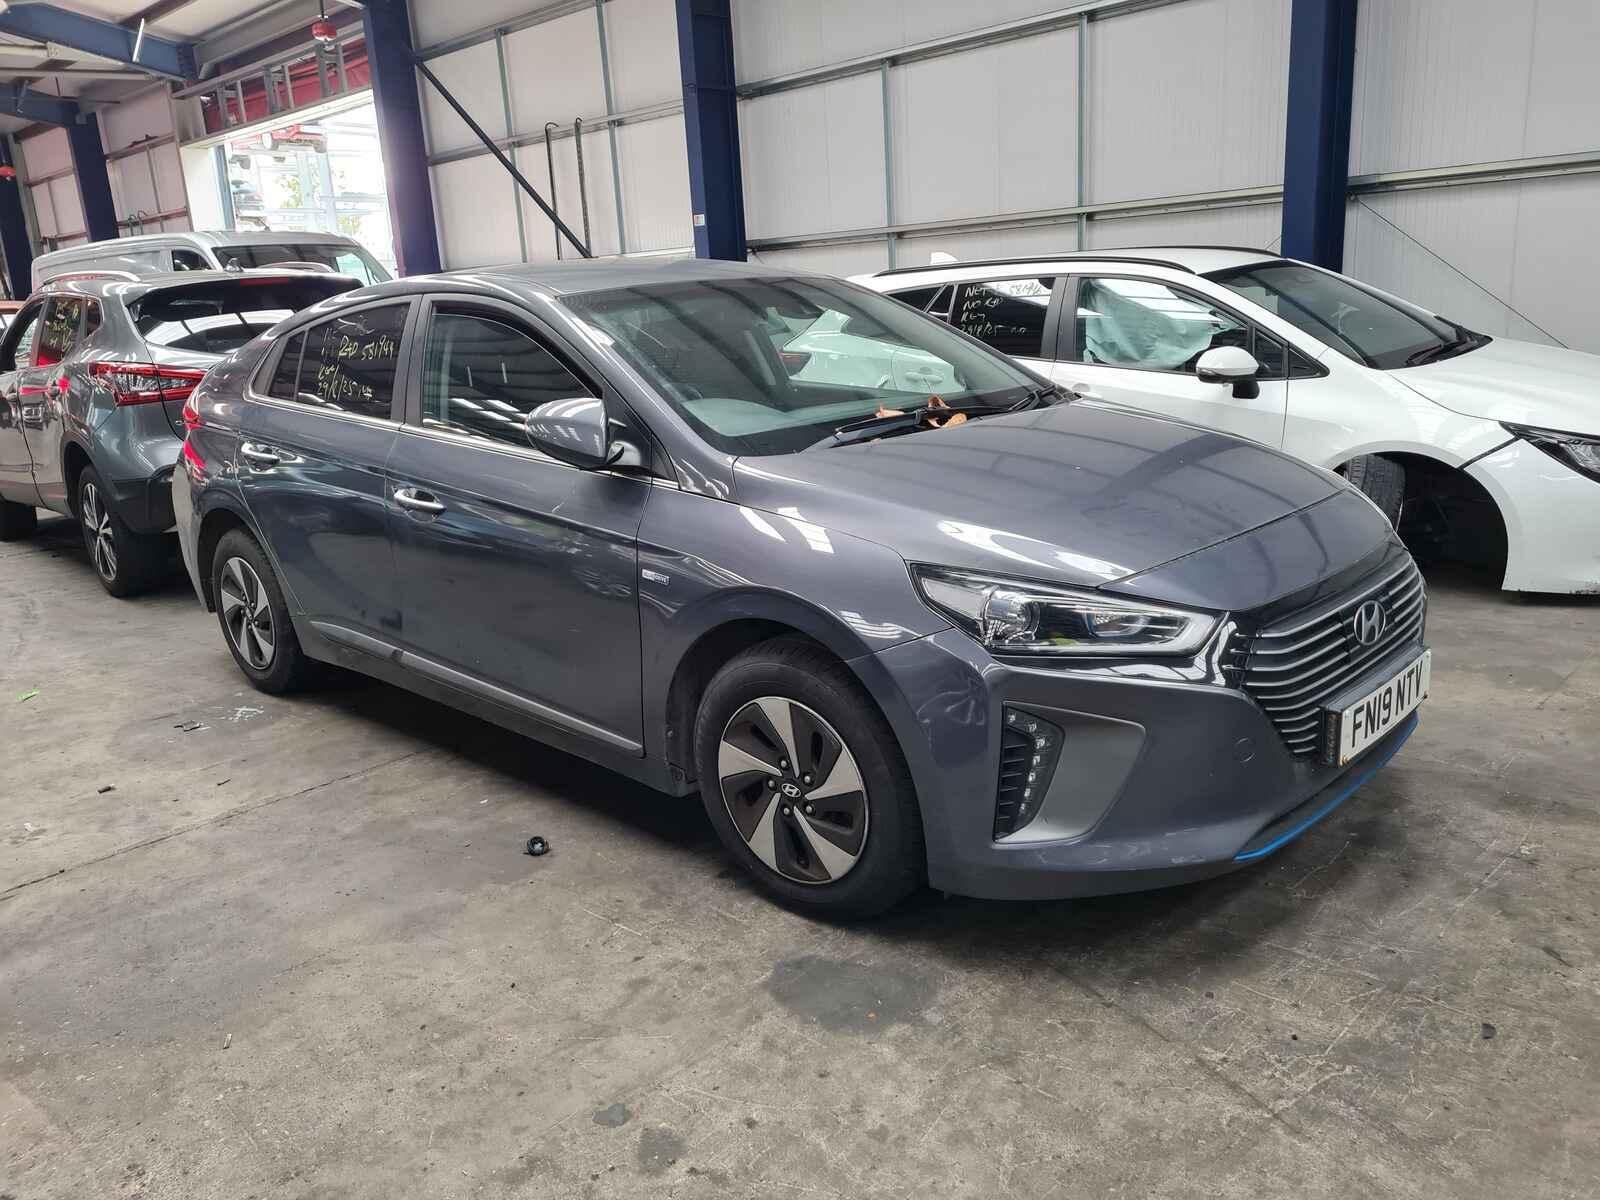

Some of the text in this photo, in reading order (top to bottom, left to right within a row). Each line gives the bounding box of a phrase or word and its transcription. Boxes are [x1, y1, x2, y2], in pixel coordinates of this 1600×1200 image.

[965, 286, 990, 298] NET
[1352, 661, 1423, 748] FN19 NTV
